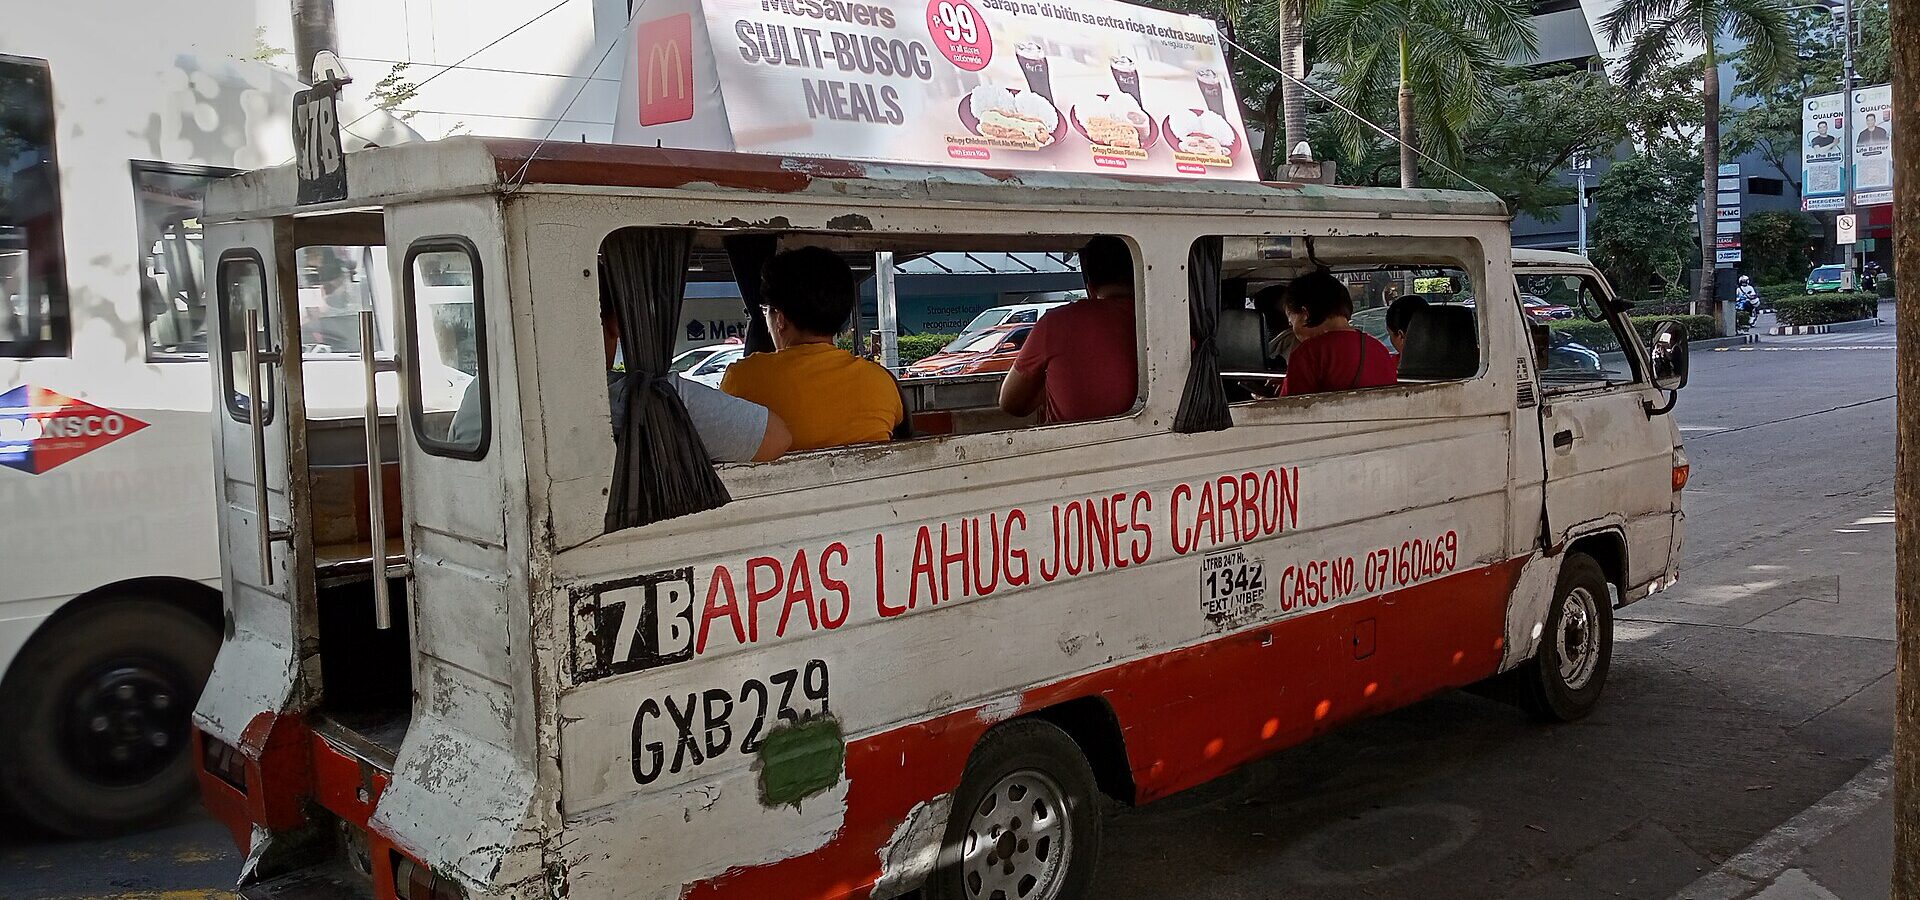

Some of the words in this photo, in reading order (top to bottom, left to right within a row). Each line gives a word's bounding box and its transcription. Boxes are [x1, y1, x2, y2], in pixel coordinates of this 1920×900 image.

[1022, 3, 1037, 15] na
[1054, 5, 1081, 22] bitin
[1083, 13, 1096, 25] sa
[1097, 15, 1125, 29] extra
[1125, 18, 1146, 34] rice
[1146, 24, 1158, 36] at
[1158, 26, 1184, 40] extra
[1185, 31, 1217, 46] sauce!
[735, 19, 932, 80] SULIT-BUSOG
[802, 78, 904, 125] MEALS
[922, 318, 962, 330] recognized
[695, 542, 851, 655] APAS
[876, 508, 1029, 618] LAHUG
[1040, 490, 1152, 583] JONES
[1170, 466, 1299, 556] CARBON
[1206, 563, 1262, 599] 1342
[1280, 560, 1329, 612] CASE
[1365, 530, 1457, 593] 07160469
